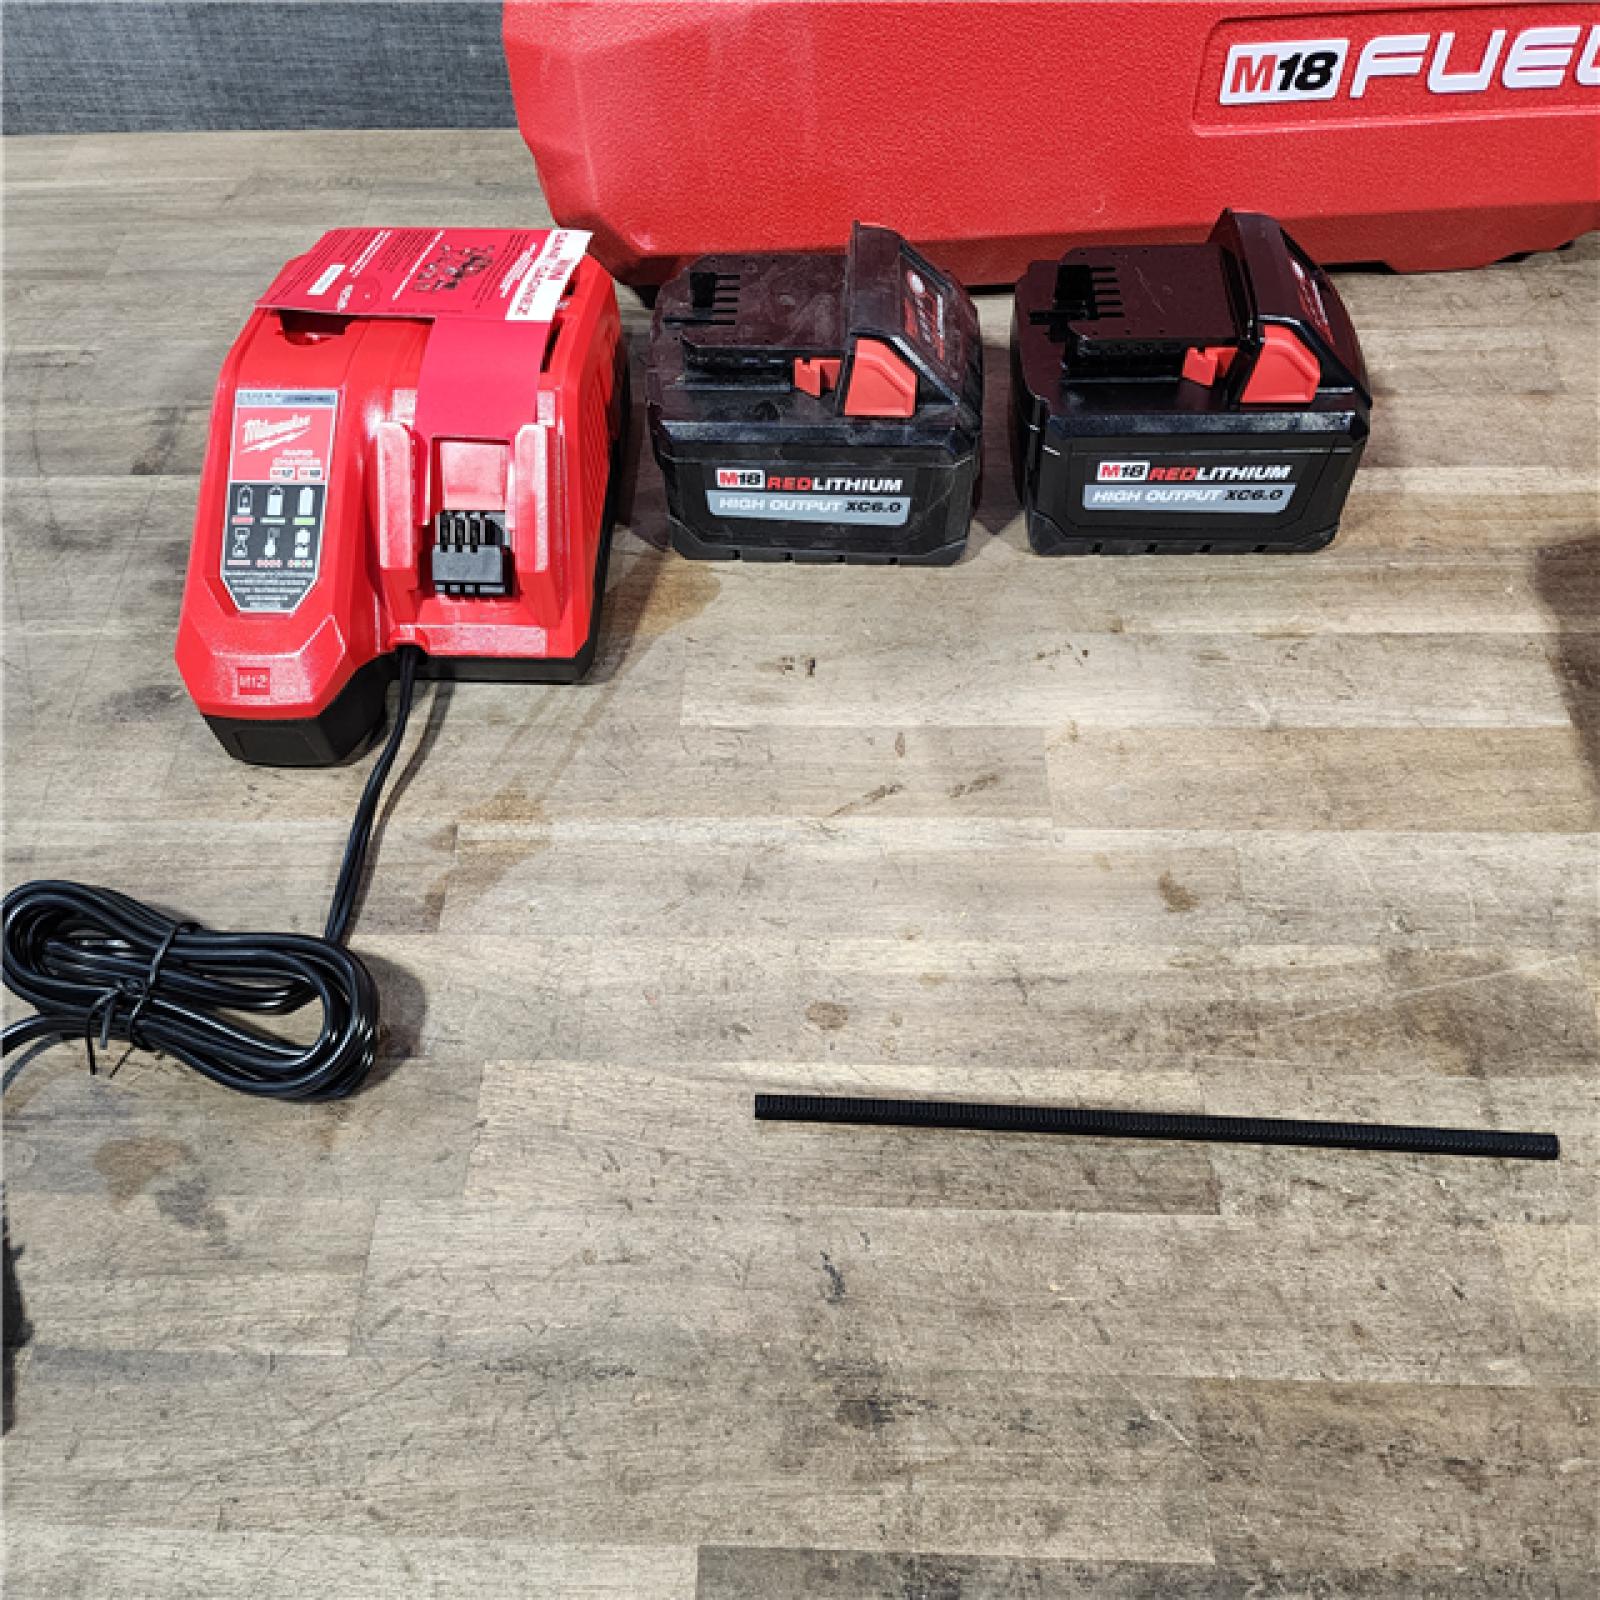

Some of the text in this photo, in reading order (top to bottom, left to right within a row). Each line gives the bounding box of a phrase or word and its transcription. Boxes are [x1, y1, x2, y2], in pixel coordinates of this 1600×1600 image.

[1229, 52, 1338, 93] M18
[719, 471, 761, 487] M18
[1101, 464, 1147, 479] M18
[1093, 489, 1285, 502] HIGH OUTPUT XC6.0
[719, 496, 903, 513] HIGH OUTPUT XC6.0
